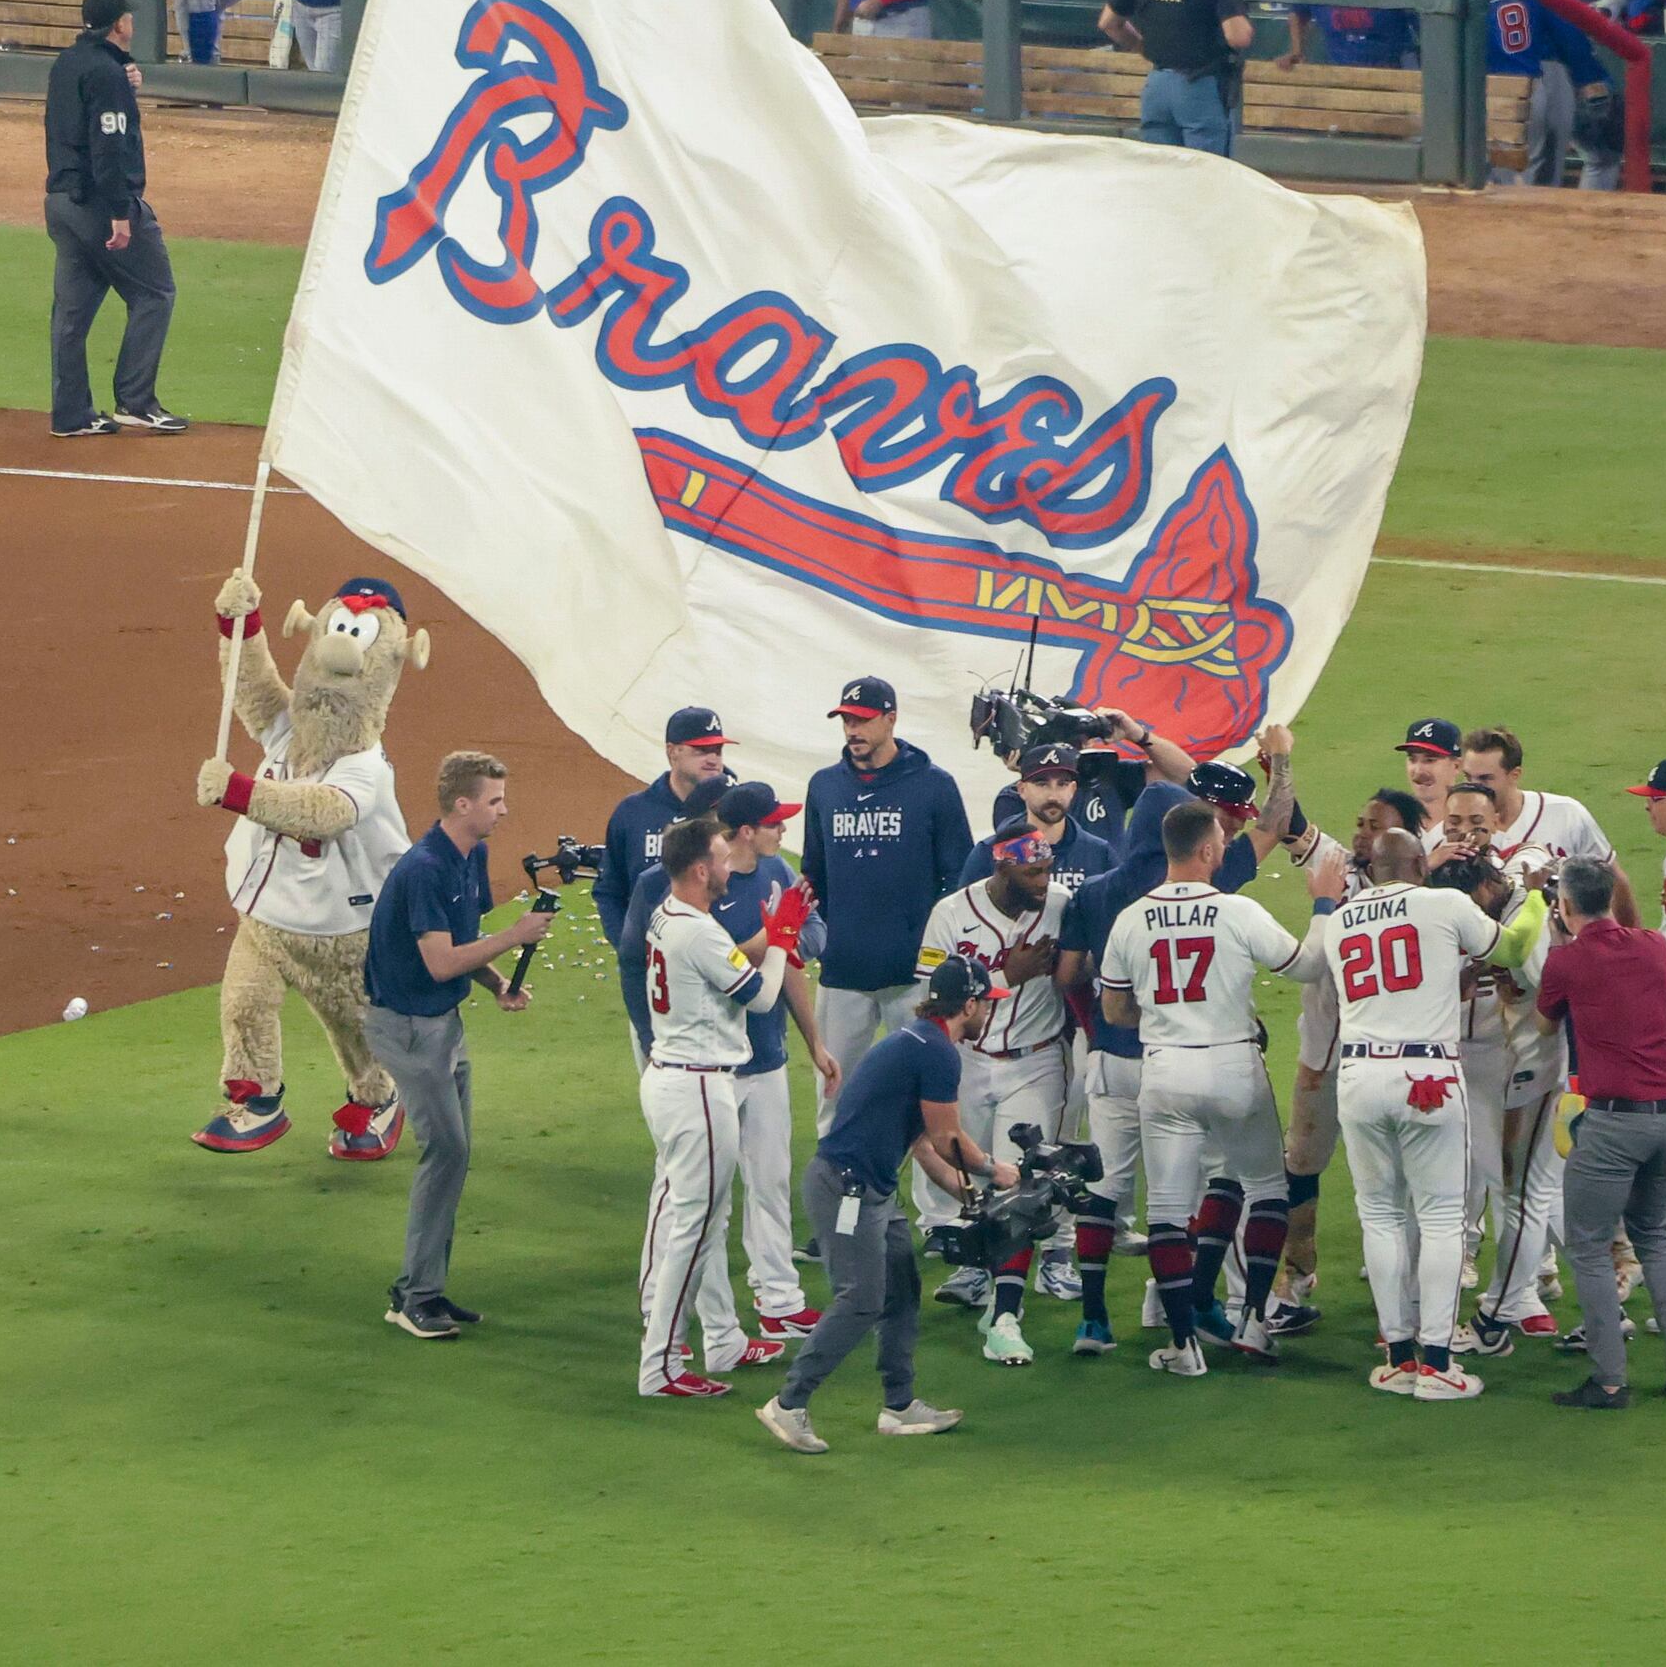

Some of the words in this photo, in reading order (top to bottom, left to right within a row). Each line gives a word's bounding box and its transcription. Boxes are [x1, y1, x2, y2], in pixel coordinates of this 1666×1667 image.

[1496, 2, 1531, 54] 8
[100, 111, 127, 135] 90
[832, 812, 902, 837] BRAVES
[1145, 905, 1219, 931] PILLAR
[1342, 898, 1409, 930] OZUNA
[1150, 936, 1216, 1004] 17
[1339, 923, 1424, 1003] 20
